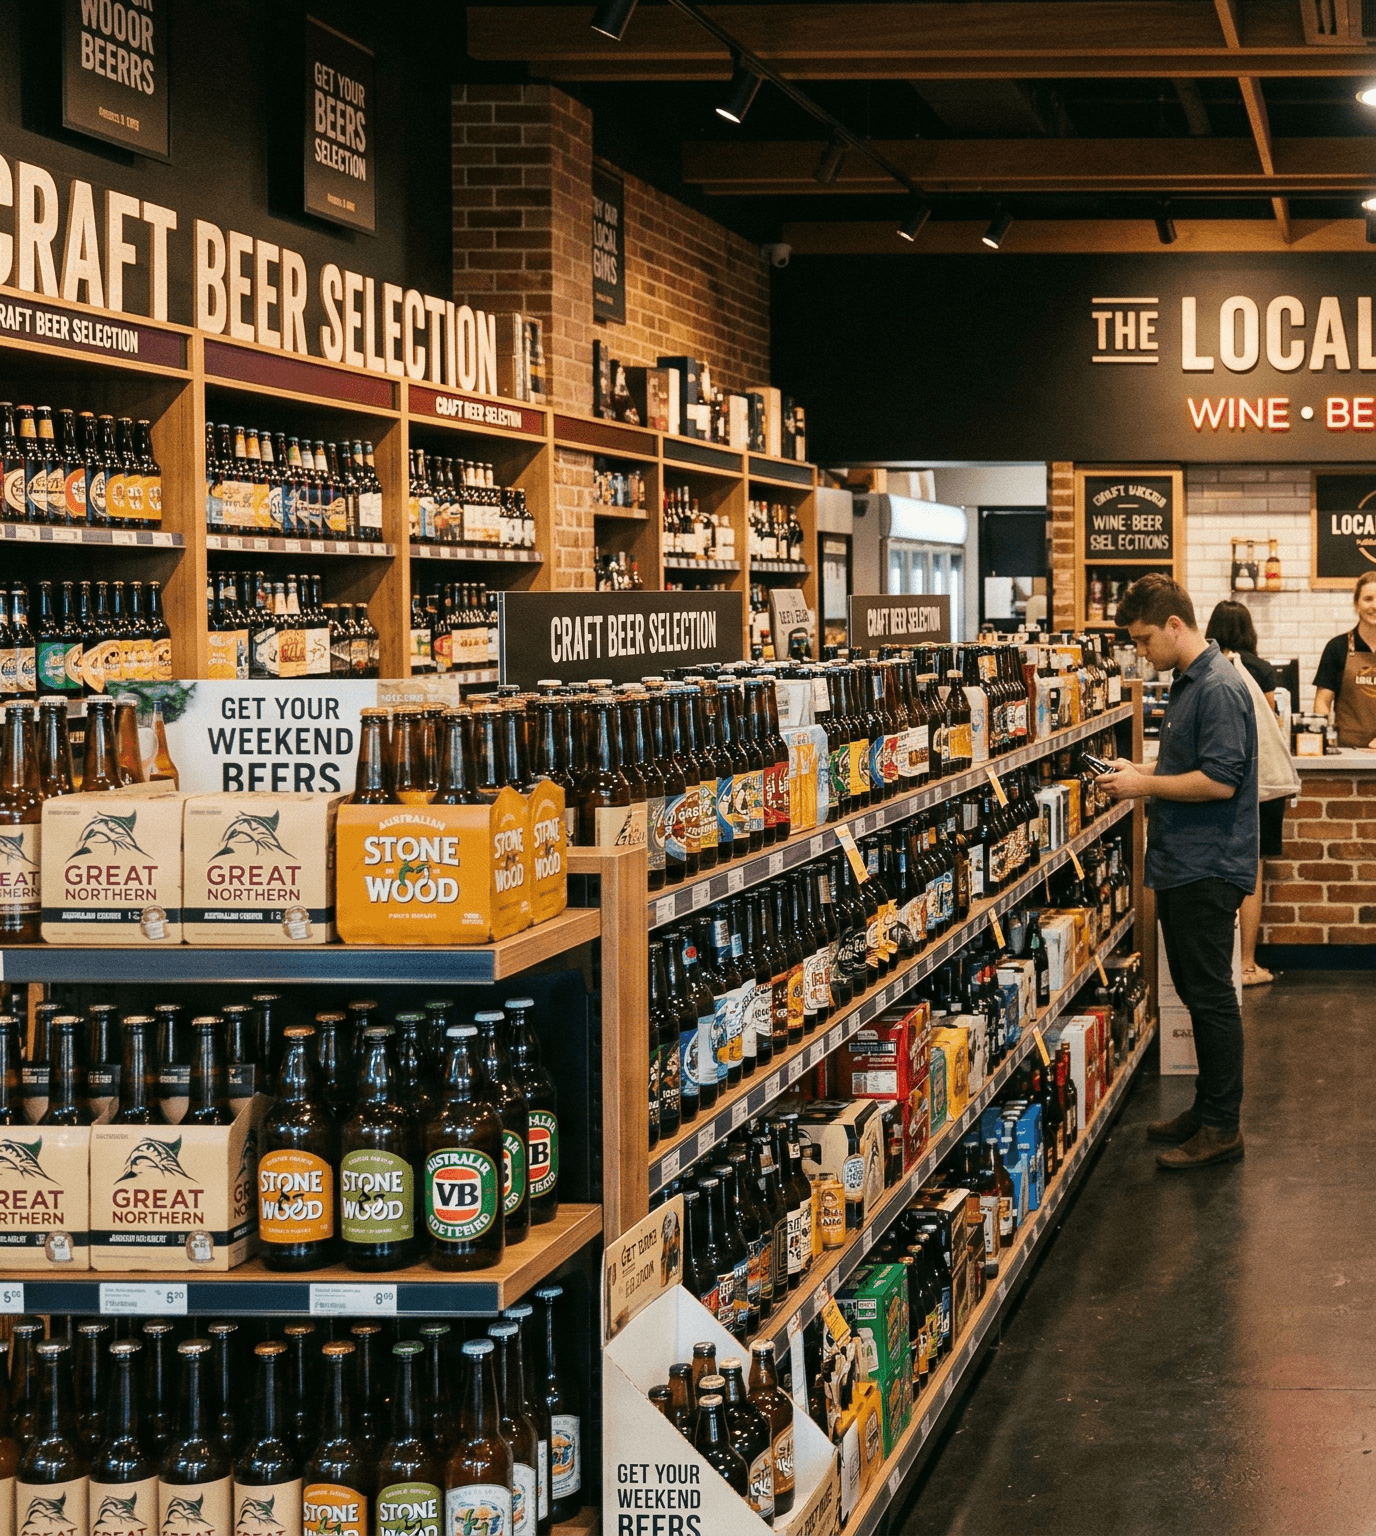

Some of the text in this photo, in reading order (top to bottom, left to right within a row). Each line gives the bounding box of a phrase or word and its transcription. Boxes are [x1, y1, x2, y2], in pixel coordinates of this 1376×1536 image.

[81, 31, 154, 95] BEERRS
[314, 61, 366, 109] GET YOUR
[315, 89, 366, 153] BEERS
[315, 137, 366, 182] SELECTION
[194, 219, 309, 355] BEER
[320, 263, 498, 397] SELECTION
[36, 311, 70, 341] BEER
[72, 318, 139, 354] SELECTION
[1092, 311, 1159, 350] THE
[1187, 397, 1291, 430] WINE
[550, 610, 717, 663] CRAFT BEER SELECTION
[222, 697, 340, 720] GET YOUR
[207, 727, 354, 755] WEEKEND
[222, 762, 341, 793] BEERS
[378, 814, 447, 832] AUSTRALIAN
[364, 836, 460, 867] STONE
[493, 827, 525, 860] STONE
[64, 865, 158, 886] GREAT
[207, 865, 302, 886] GREAT
[494, 862, 525, 894] WOOD
[534, 851, 562, 882] WOOD
[65, 888, 157, 901] NORTHERN
[207, 888, 301, 901] NORTHERN
[364, 876, 460, 904] WOOD
[260, 1170, 323, 1193] STONE
[342, 1169, 404, 1193] STONE
[112, 1188, 205, 1209] GREAT
[434, 1182, 480, 1208] VB
[112, 1211, 204, 1225] NORTHERN
[261, 1197, 324, 1221] WOOD
[343, 1197, 404, 1221] WOOD
[617, 1463, 701, 1484] GET YOUR
[379, 1499, 438, 1522] STONE
[617, 1488, 701, 1509] WEEKEND
[303, 1501, 360, 1523] STONE
[618, 1513, 702, 1536] BEERS
